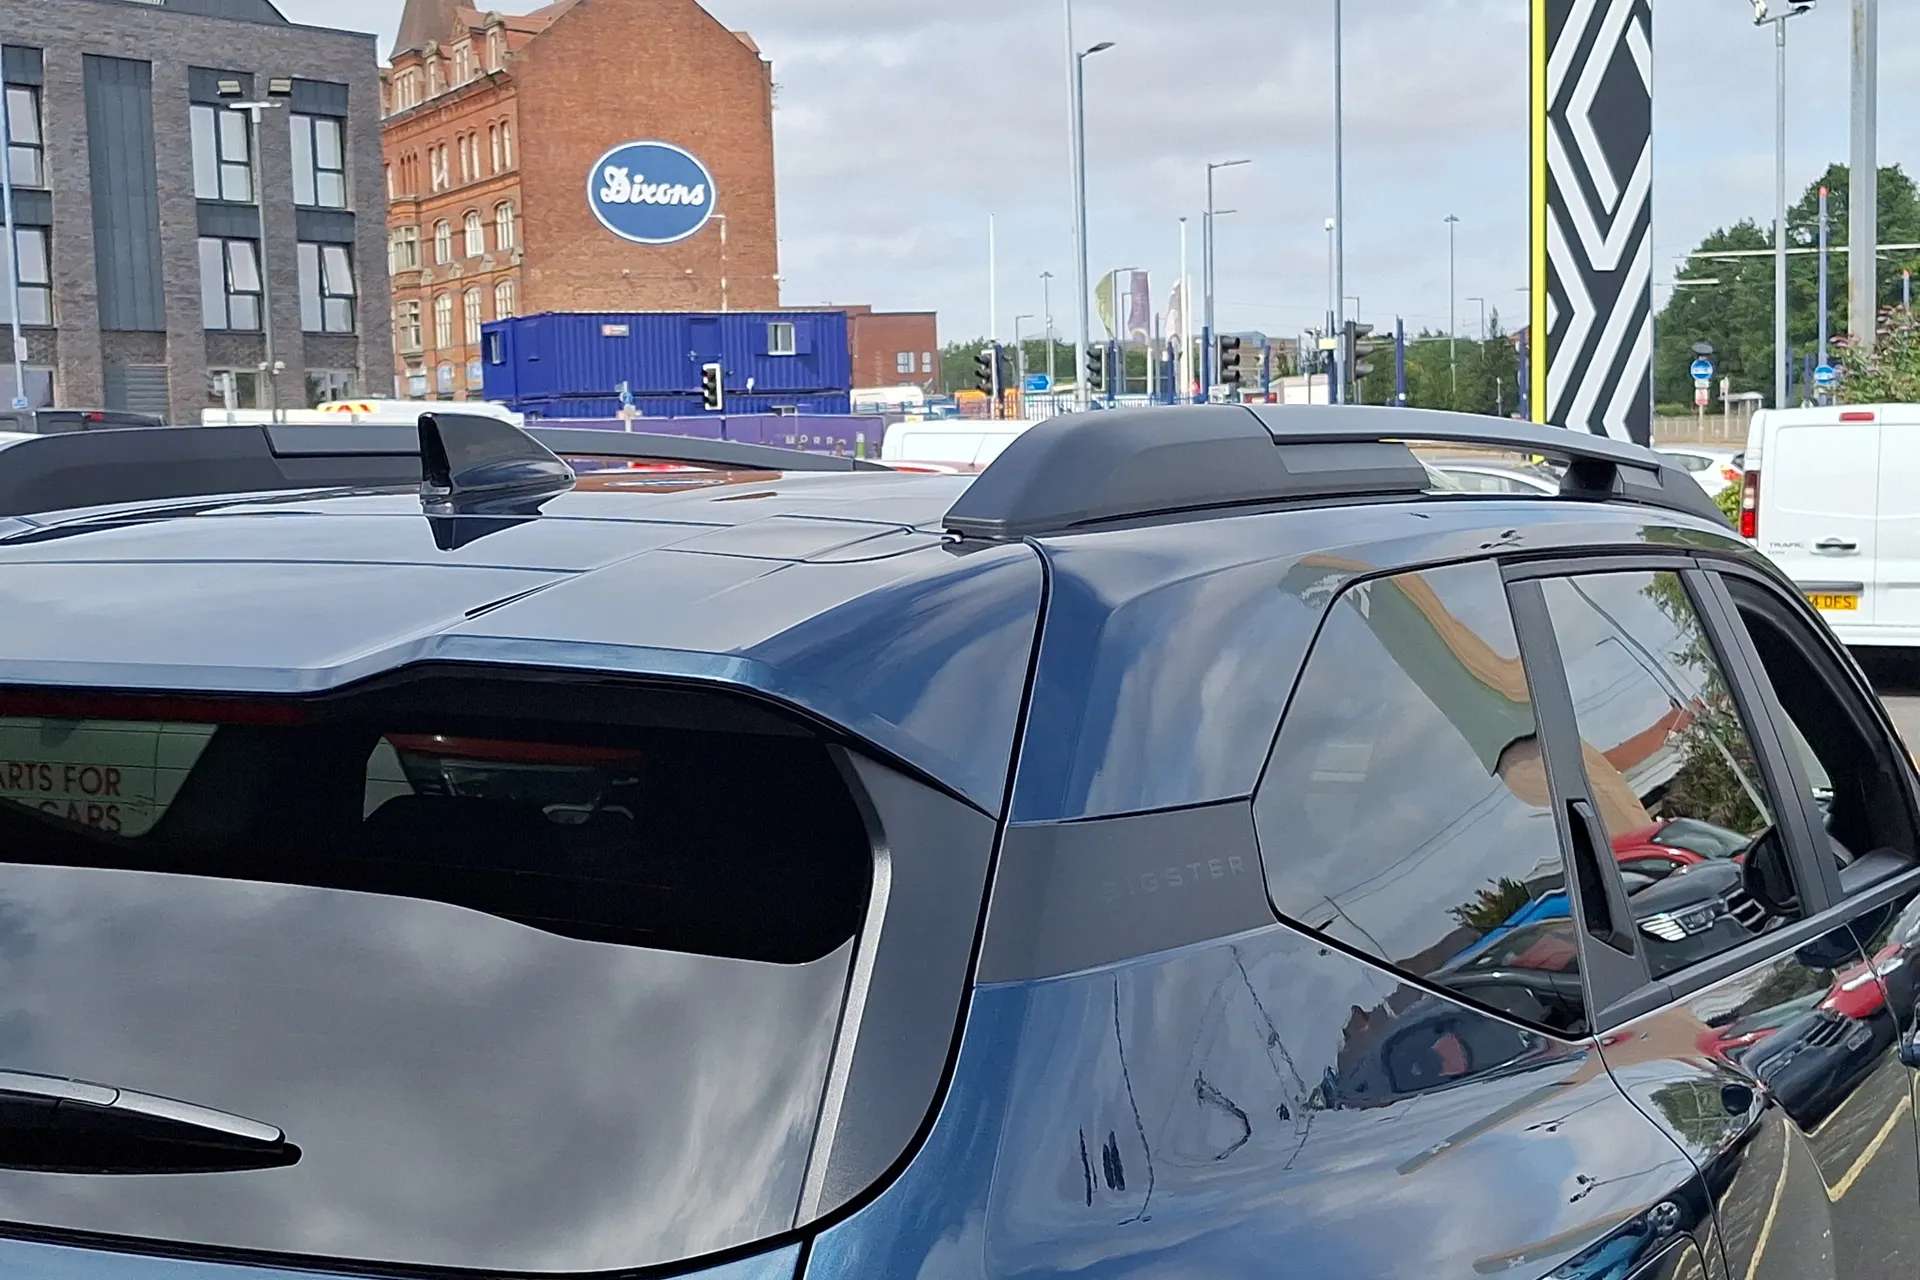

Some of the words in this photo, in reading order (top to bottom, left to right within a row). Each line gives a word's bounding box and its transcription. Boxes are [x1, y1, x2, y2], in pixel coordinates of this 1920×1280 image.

[600, 166, 705, 206] Dixons
[1824, 595, 1852, 608] DFS
[64, 766, 120, 796] FOR
